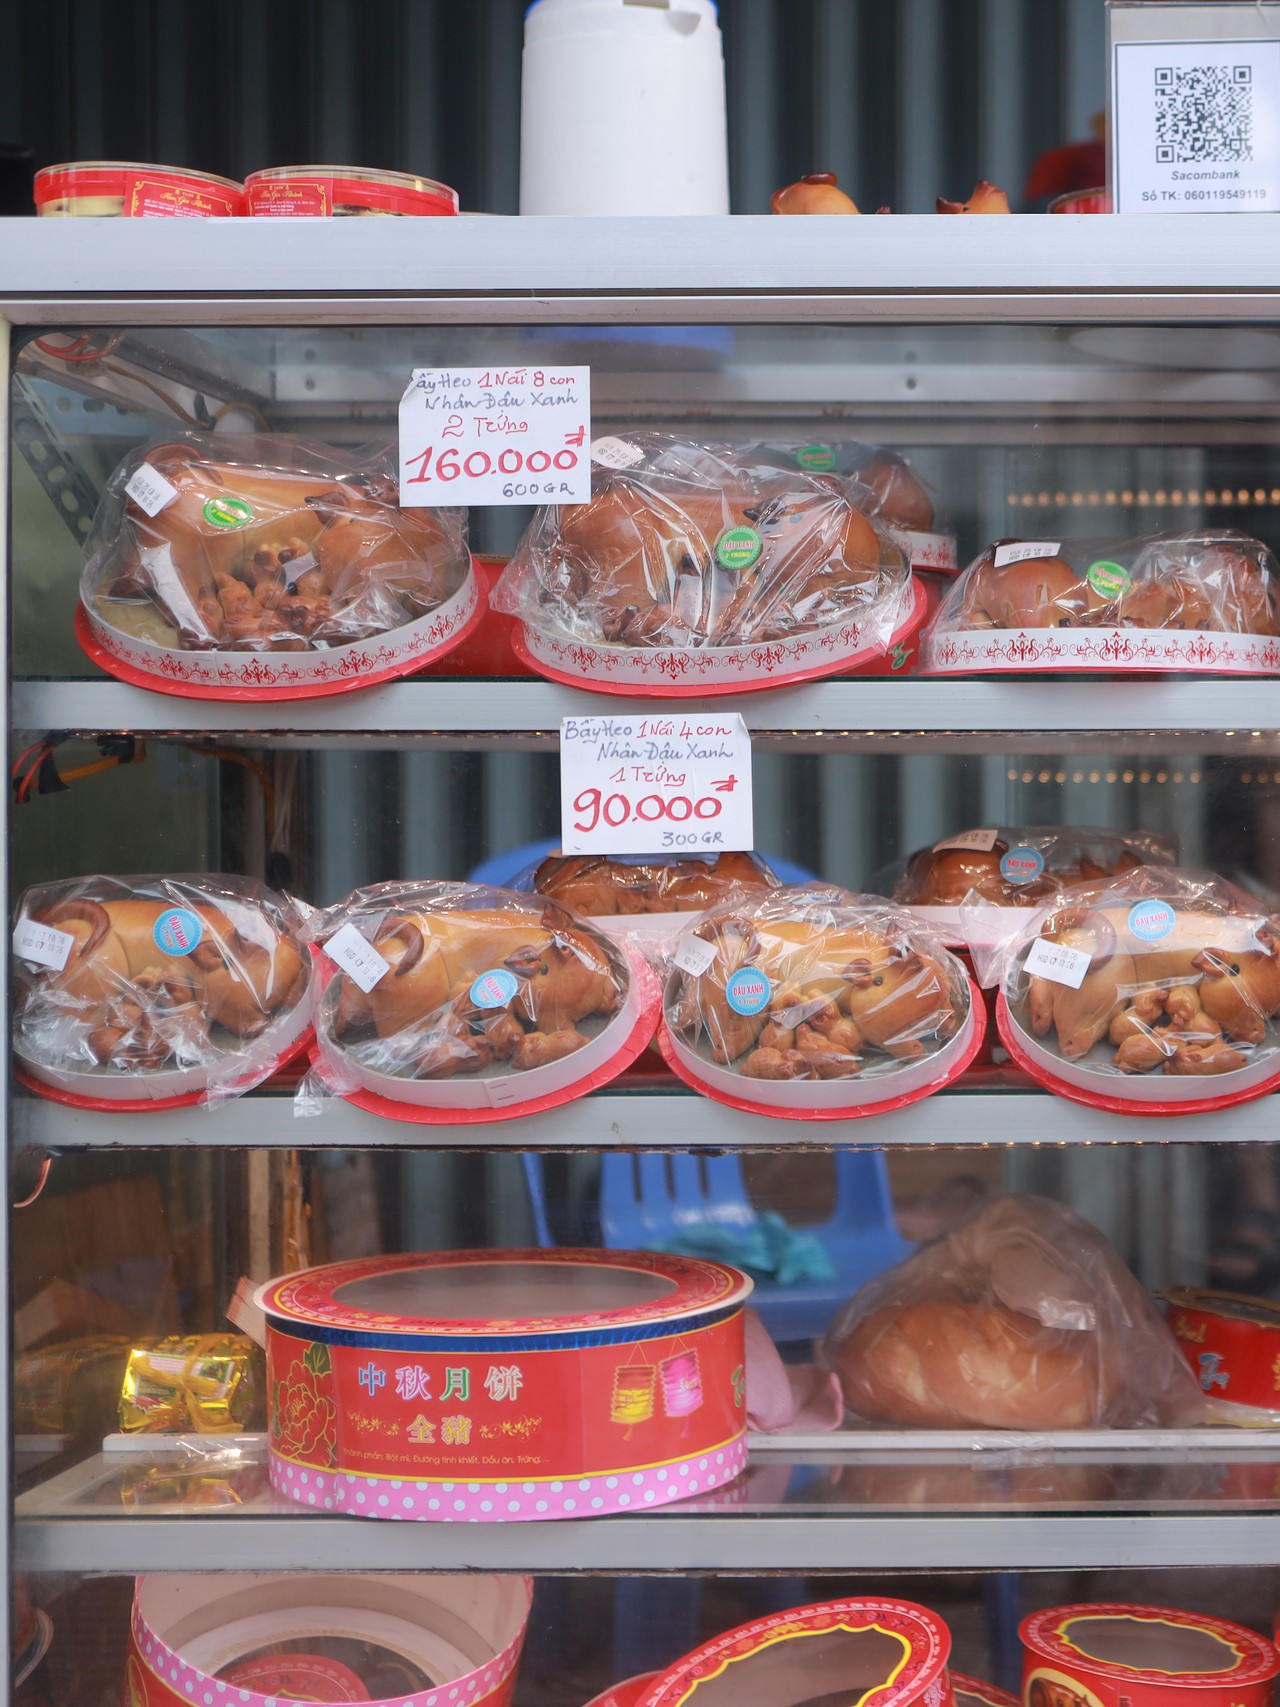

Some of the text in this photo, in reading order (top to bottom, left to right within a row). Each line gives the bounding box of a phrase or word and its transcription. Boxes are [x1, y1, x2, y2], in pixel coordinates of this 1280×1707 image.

[1172, 170, 1240, 180] Sacombank
[1161, 192, 1180, 200] TK:
[533, 371, 544, 387] 8
[550, 376, 575, 385] con
[531, 388, 578, 406] Xanh
[442, 415, 464, 438] 2
[600, 720, 632, 736] Heo
[680, 721, 692, 739] 4
[697, 726, 732, 736] con
[687, 743, 733, 759] Xanh
[609, 767, 626, 782] 1
[358, 1361, 524, 1401] 中秋月饼
